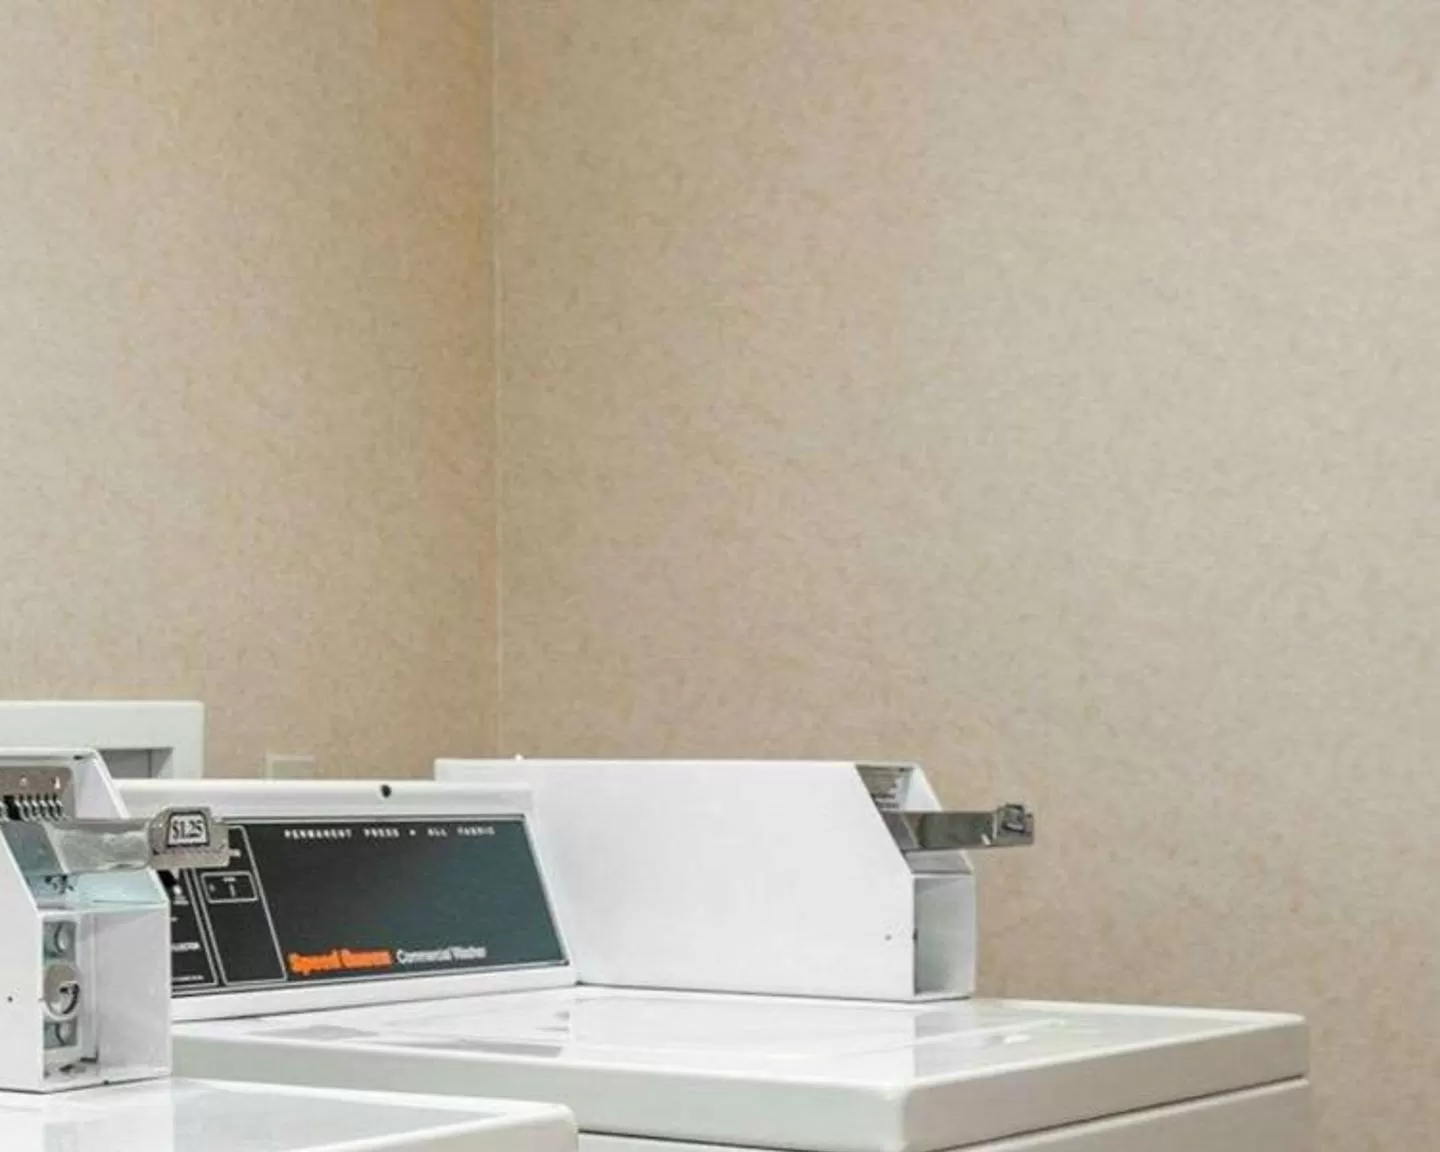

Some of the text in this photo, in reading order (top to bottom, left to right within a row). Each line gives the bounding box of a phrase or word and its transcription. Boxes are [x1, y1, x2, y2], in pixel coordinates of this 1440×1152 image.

[172, 819, 205, 840] $1.25
[284, 828, 353, 839] PERMANENT
[364, 827, 400, 838] PRESS
